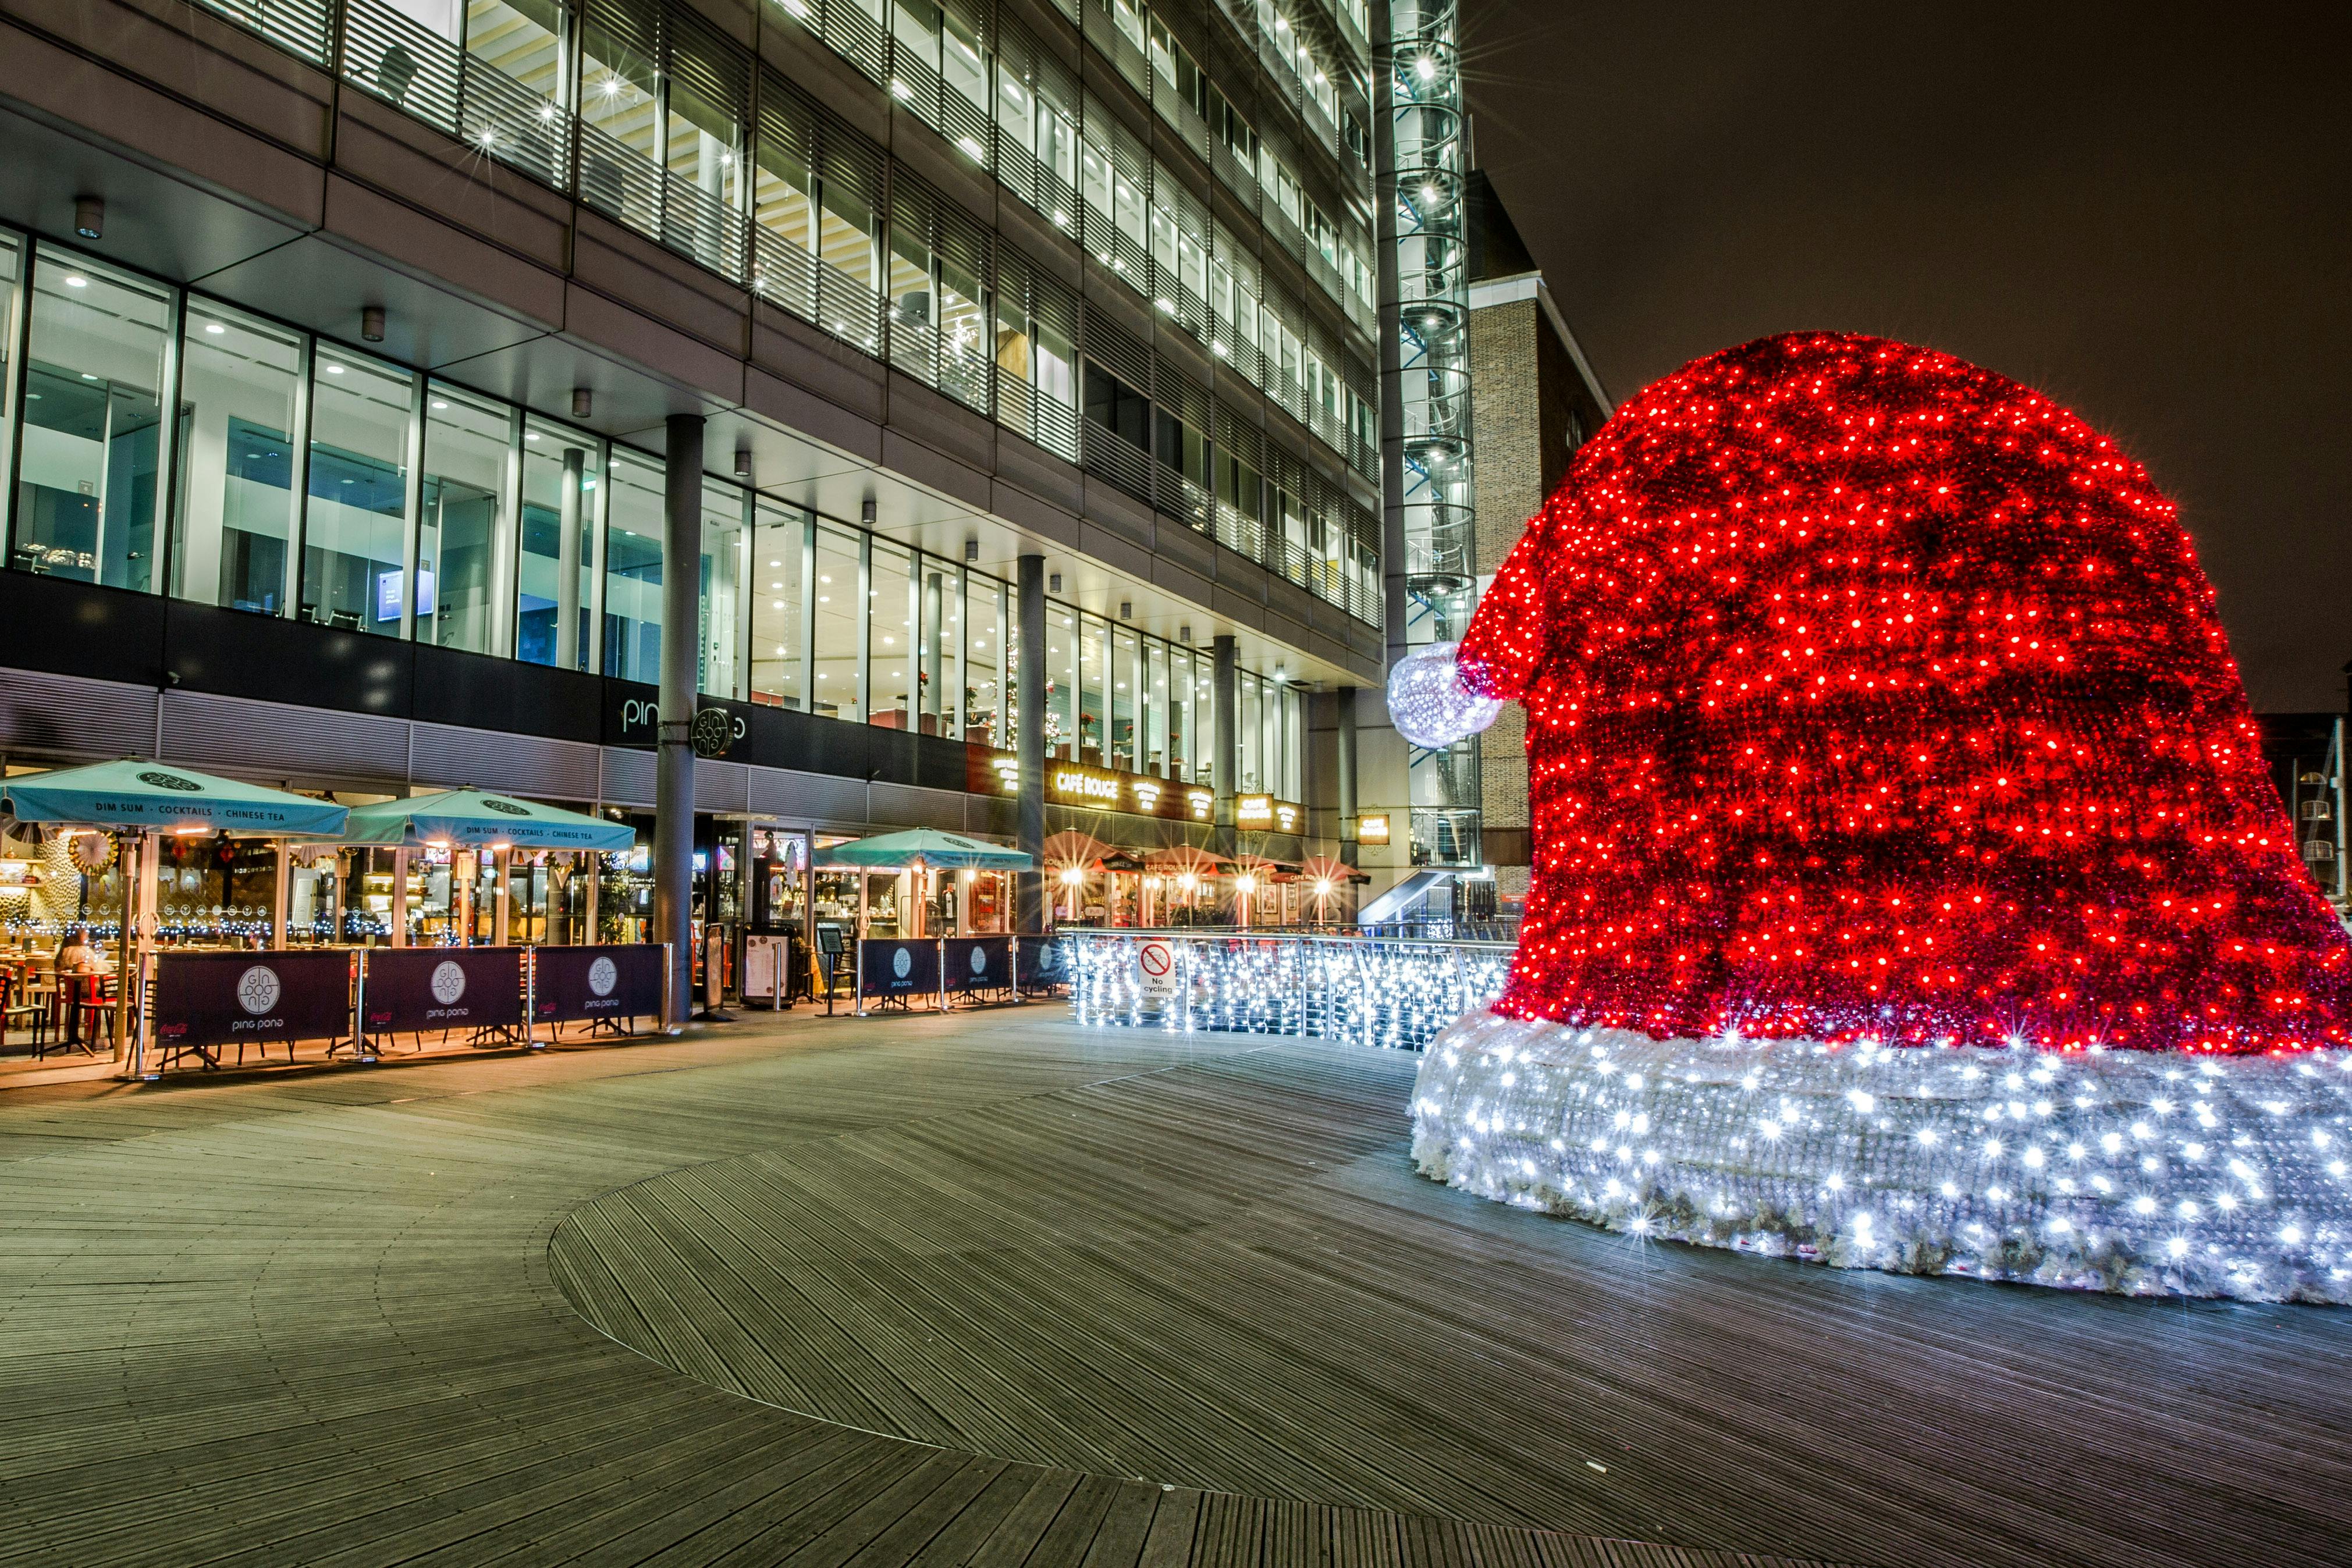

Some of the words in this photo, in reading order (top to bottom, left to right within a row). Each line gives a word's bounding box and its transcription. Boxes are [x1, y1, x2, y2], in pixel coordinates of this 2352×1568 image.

[1085, 777, 1117, 799] ROUGE
[95, 802, 116, 811] DIM
[121, 803, 143, 812] SUM
[158, 805, 212, 816] COCKTAILS
[226, 809, 264, 820] CHINESE
[268, 813, 285, 822] TEA
[507, 828, 543, 836] COCKTAILS
